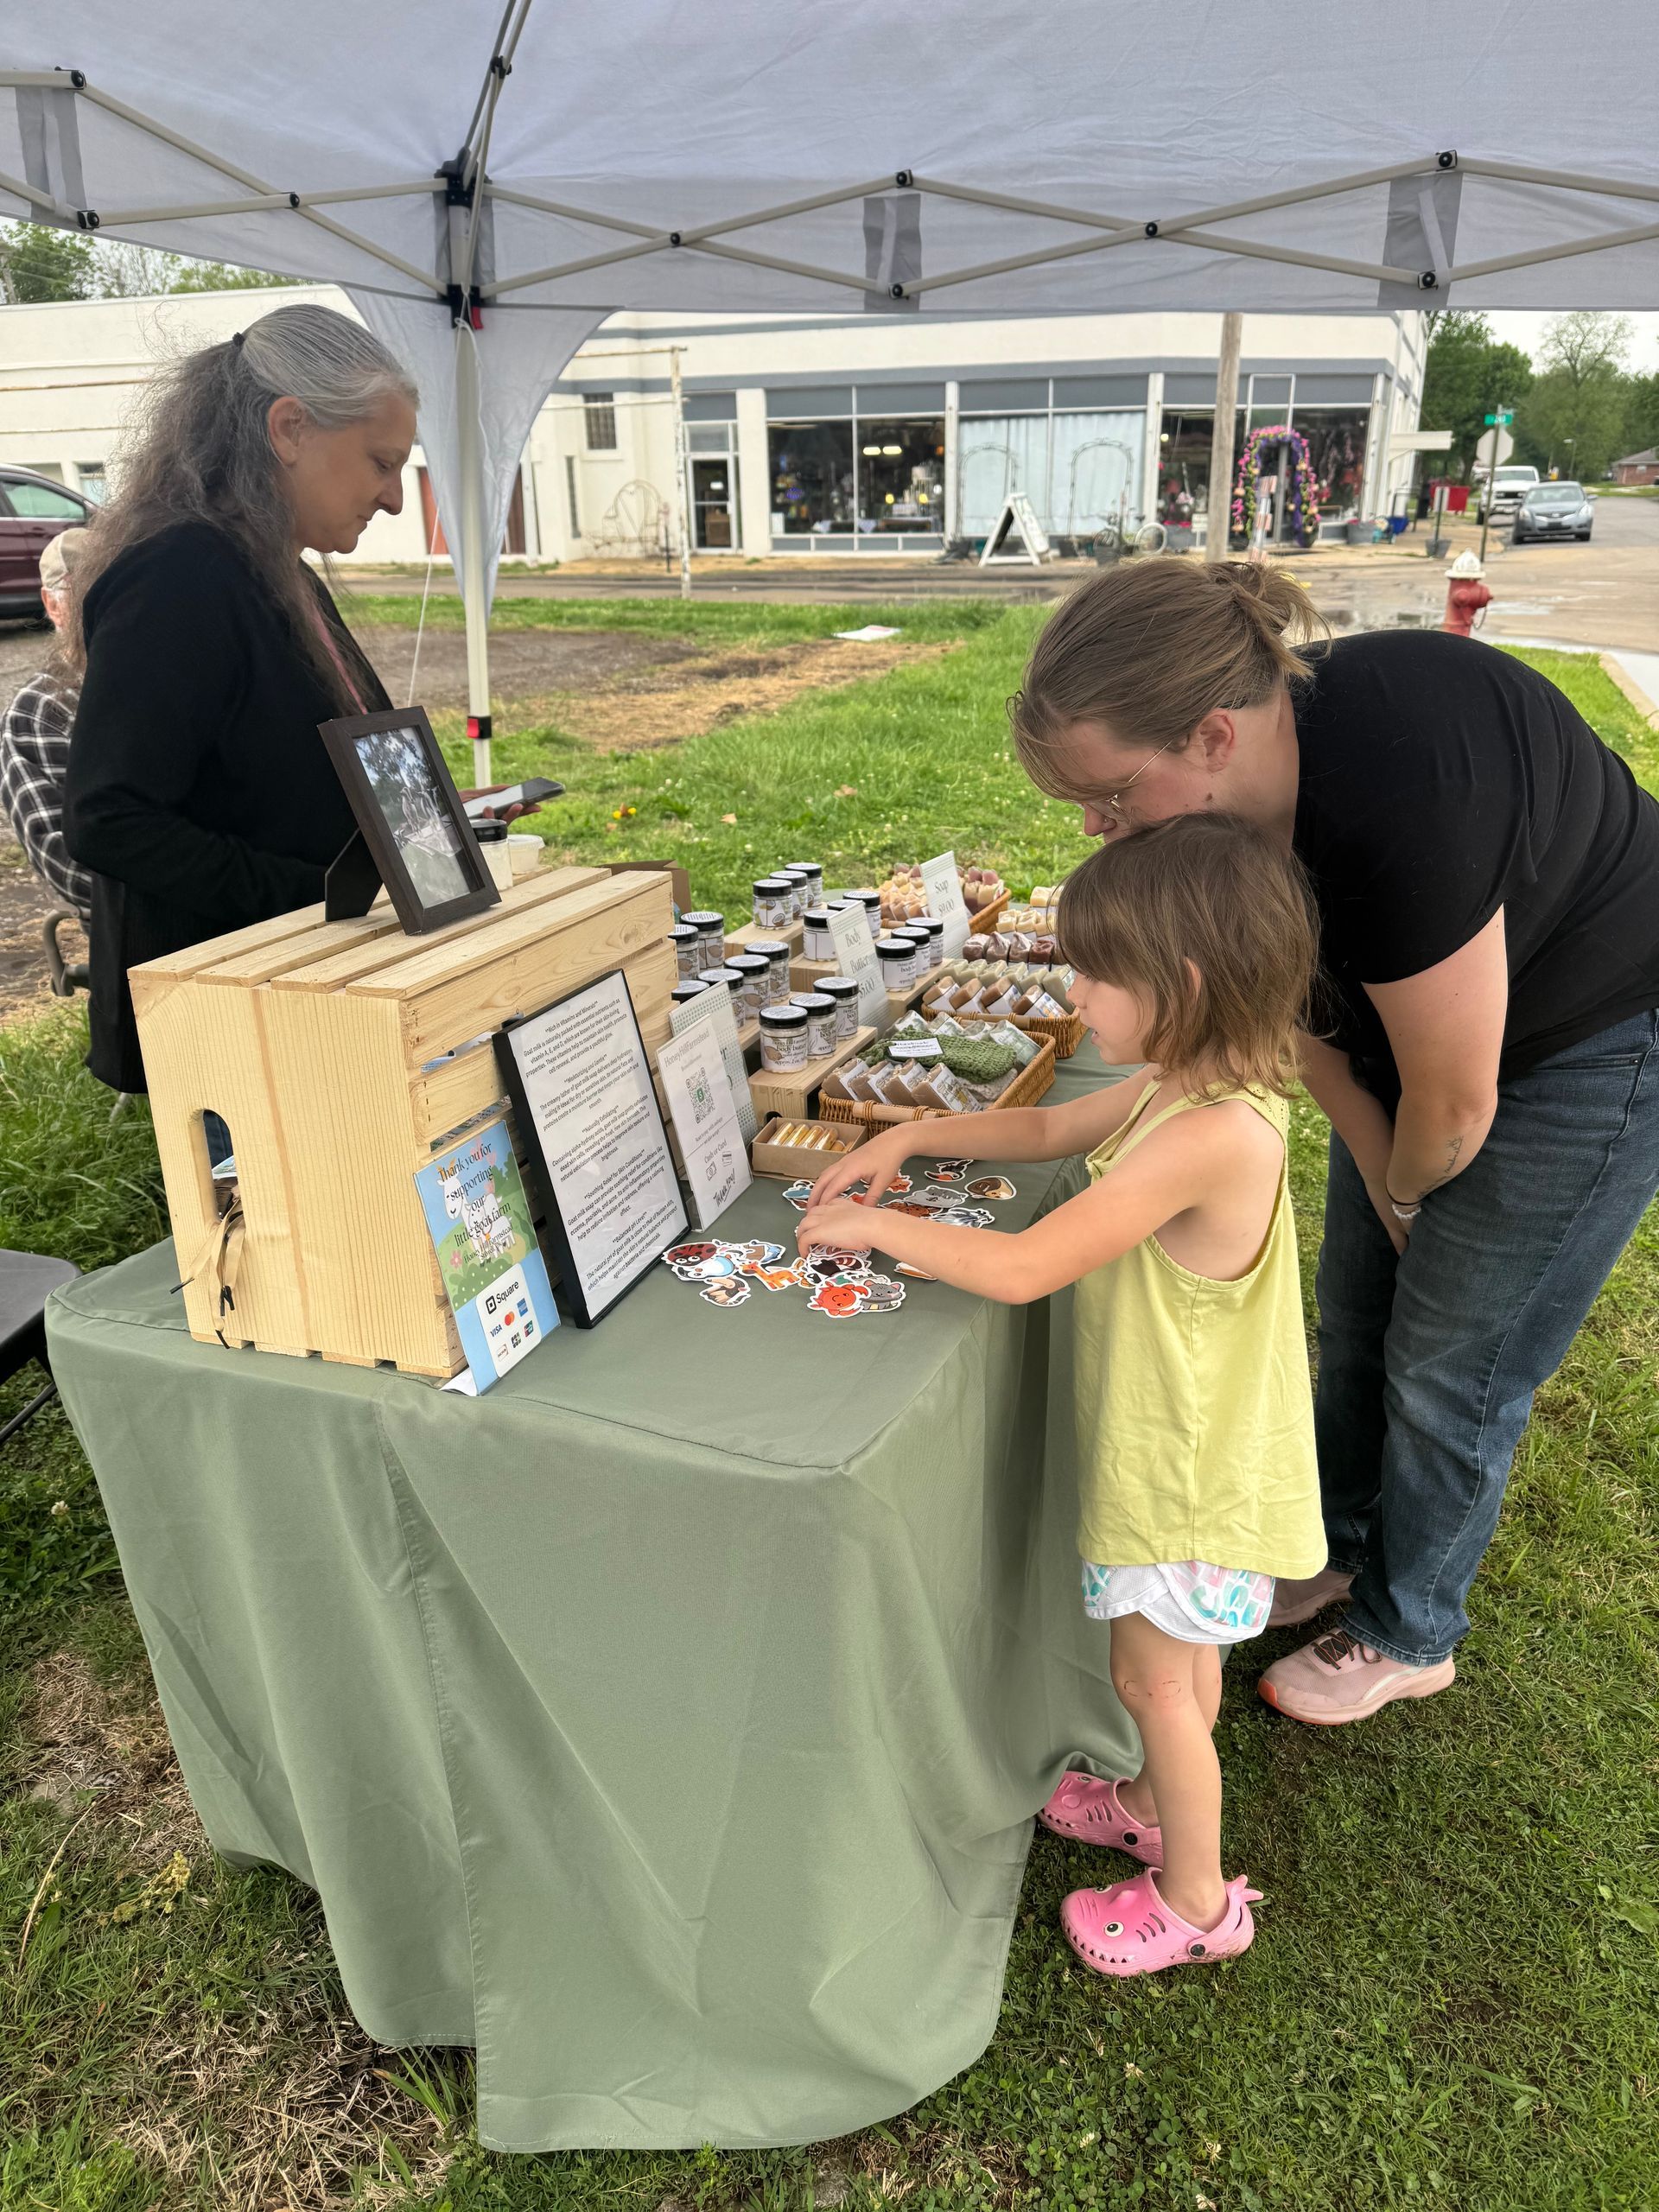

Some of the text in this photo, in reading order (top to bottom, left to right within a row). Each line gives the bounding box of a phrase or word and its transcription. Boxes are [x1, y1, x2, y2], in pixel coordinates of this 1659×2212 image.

[934, 880, 948, 893] Soap
[845, 928, 861, 948] Body
[850, 955, 869, 974] Butter
[438, 1143, 492, 1182] Thank you for
[704, 1151, 714, 1164] Cash
[718, 1138, 727, 1151] Card
[450, 1166, 493, 1201] supporting
[713, 1167, 735, 1207] THANK YOU!
[472, 1196, 485, 1211] our
[454, 1203, 511, 1247] little goat farm
[464, 1249, 480, 1263] Honey
[489, 1222, 513, 1245] Farmstead
[496, 1281, 519, 1304] Square
[490, 1324, 503, 1338] VISA
